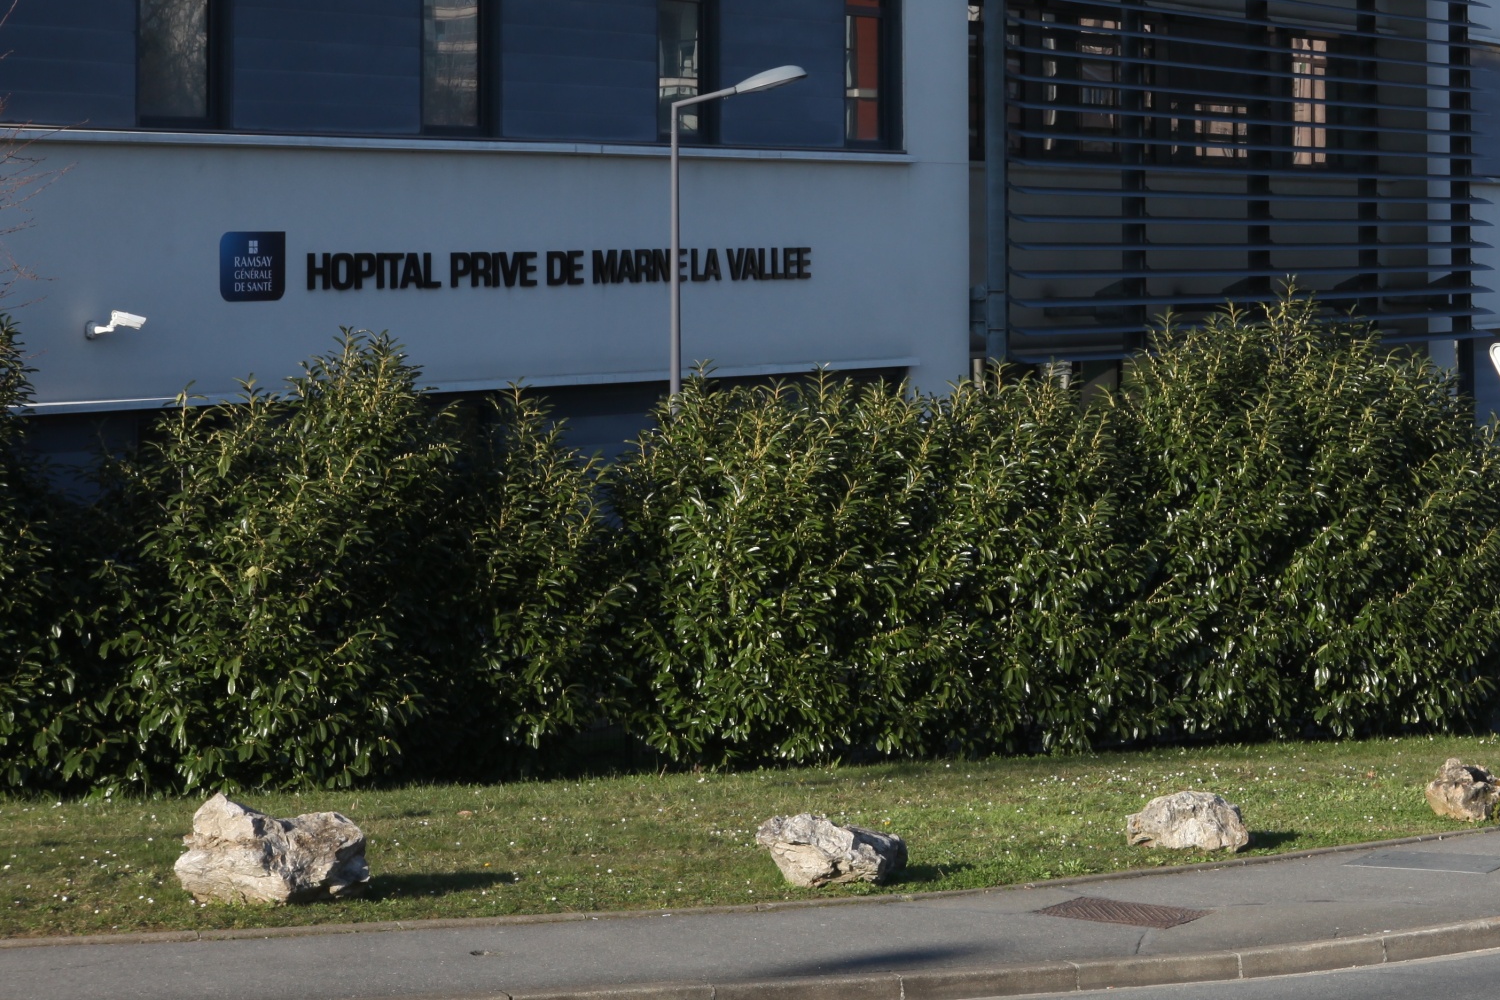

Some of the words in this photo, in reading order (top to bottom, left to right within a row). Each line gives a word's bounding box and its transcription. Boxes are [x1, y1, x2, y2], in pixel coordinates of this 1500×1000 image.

[234, 256, 273, 267] RAMSAY
[234, 268, 272, 279] GÉNÉRALE
[306, 252, 442, 291] HOPITAL
[450, 251, 538, 288] PRIVE
[546, 250, 585, 287] DE
[592, 249, 688, 284] MARNE
[691, 248, 722, 281] LA
[725, 247, 812, 281] VALLEE
[234, 282, 245, 292] DE
[247, 280, 272, 291] SANTÉ
